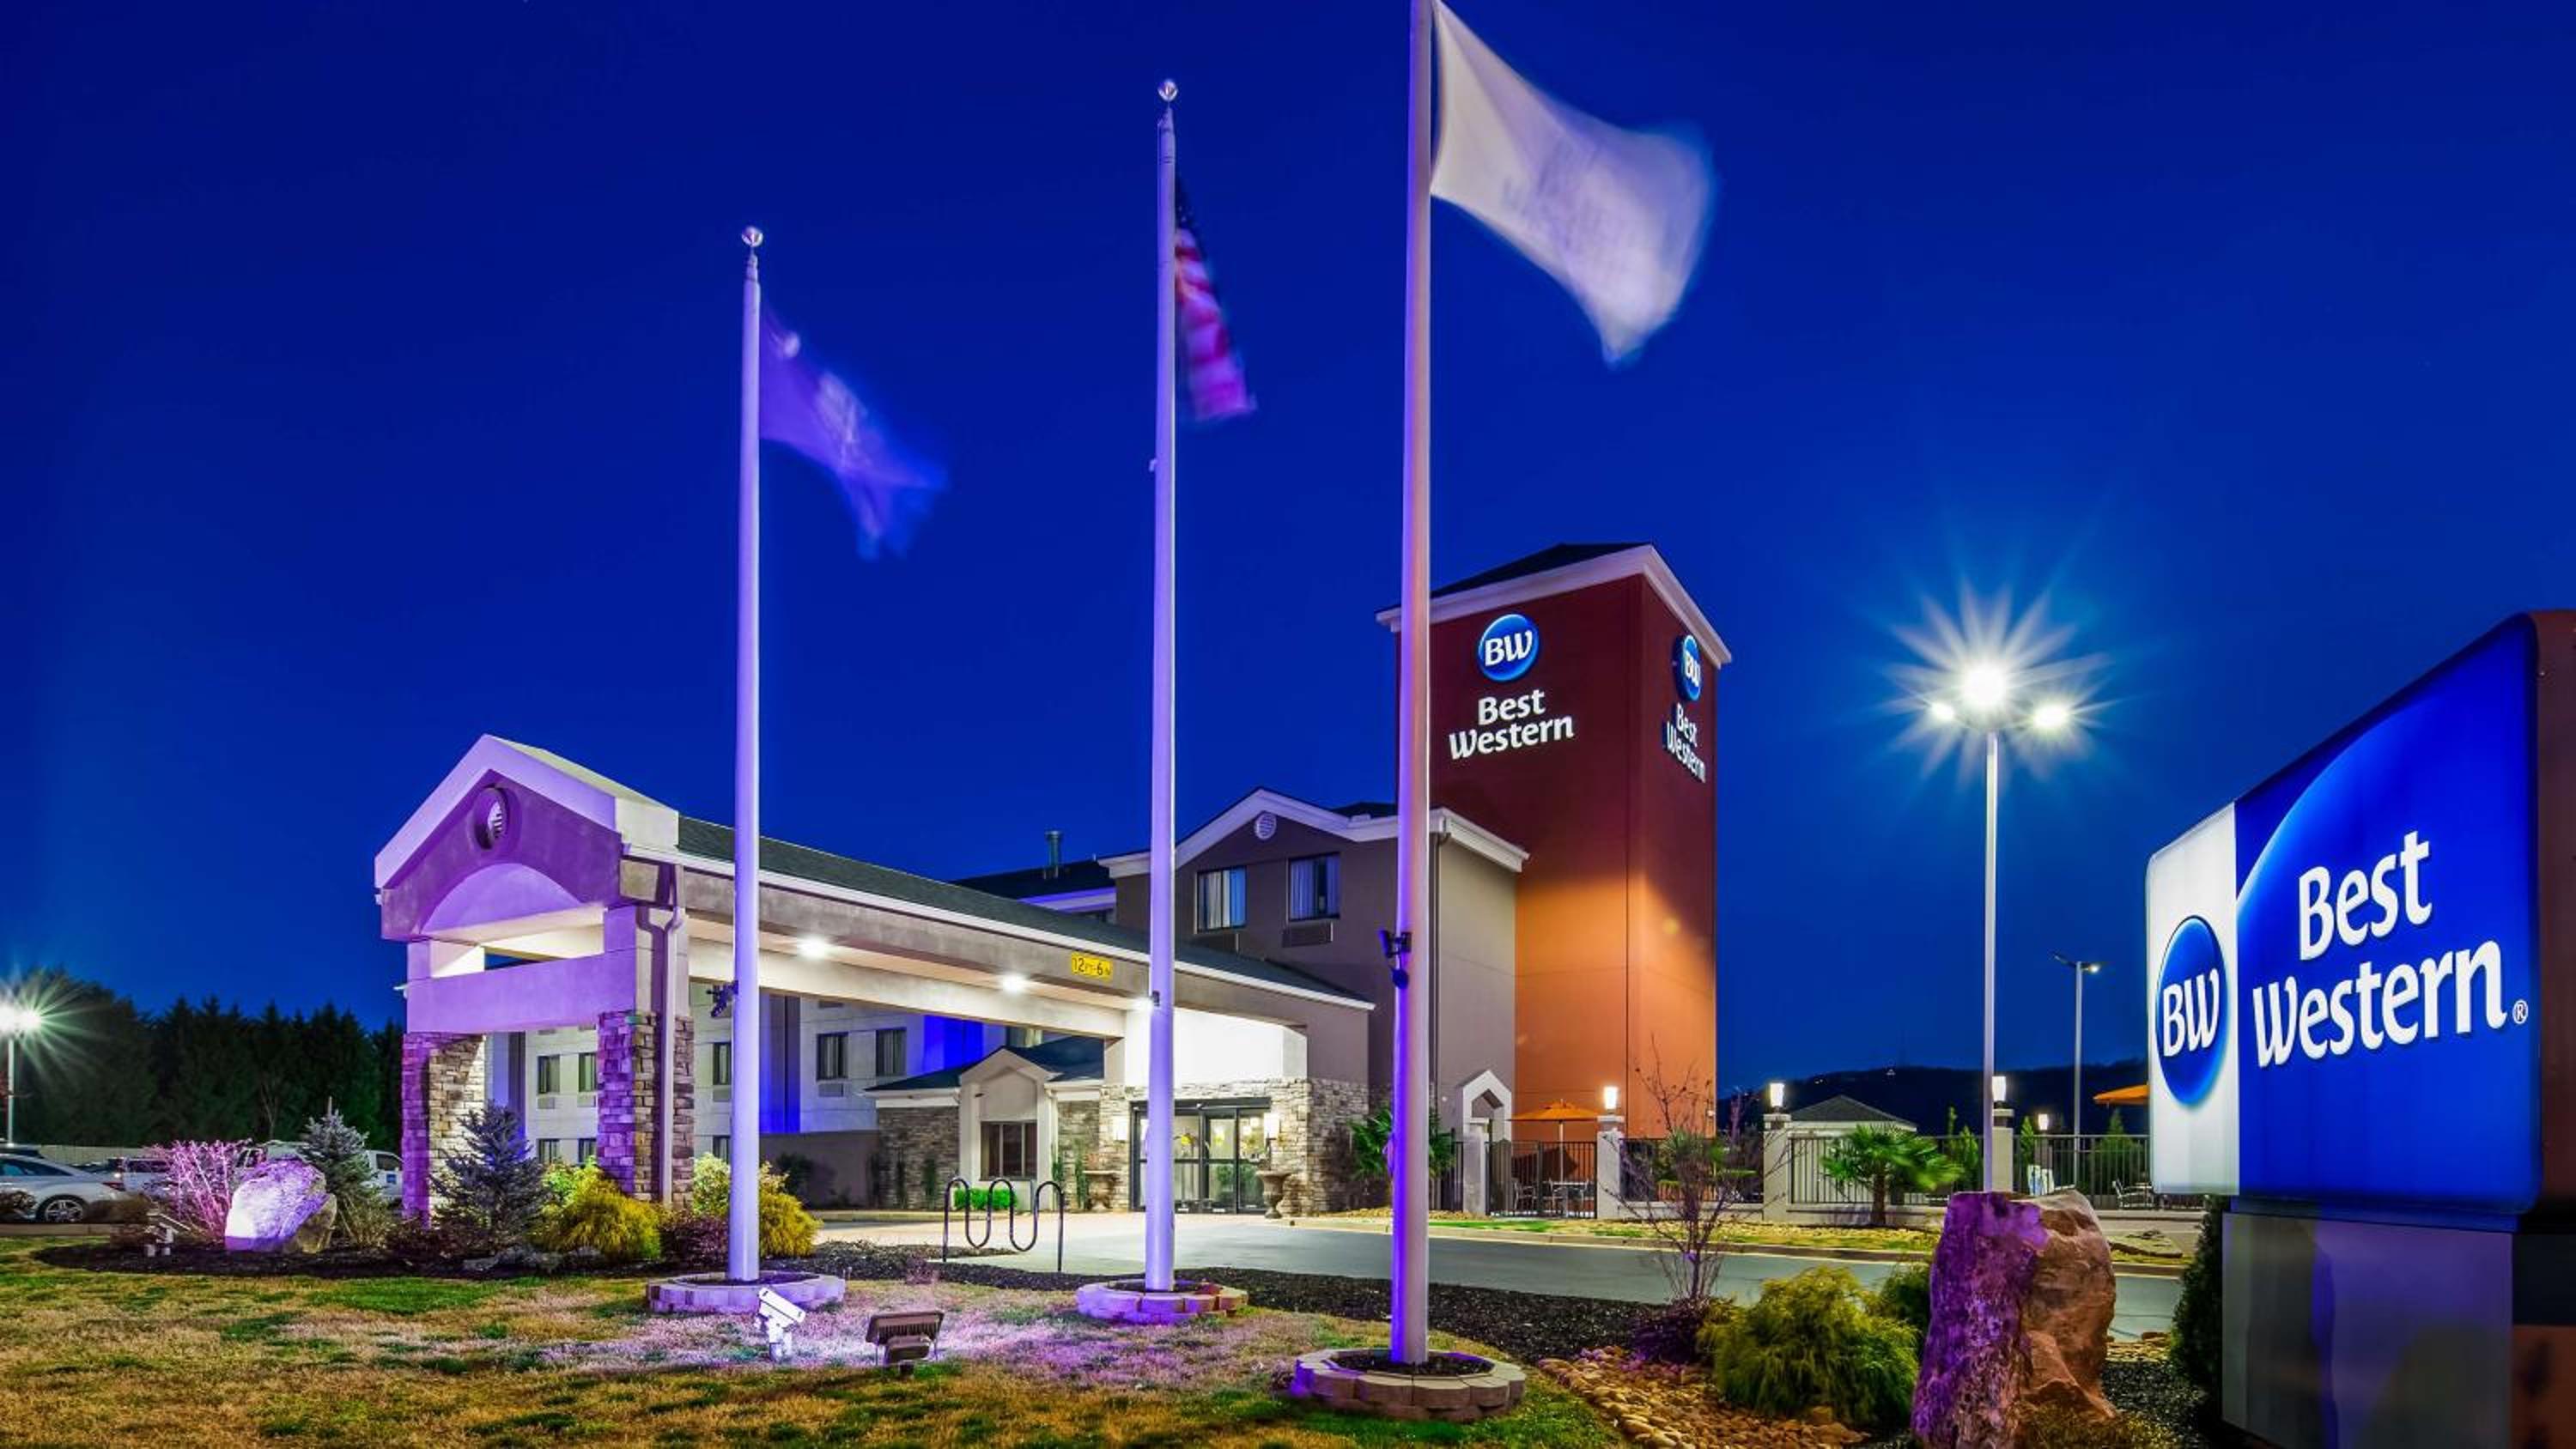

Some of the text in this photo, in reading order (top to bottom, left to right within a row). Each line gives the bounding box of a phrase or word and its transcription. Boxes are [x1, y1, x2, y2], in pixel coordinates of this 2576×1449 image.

[1484, 630, 1533, 666] BW
[1685, 650, 1701, 688] BW
[1478, 689, 1546, 725] Best
[1677, 702, 1698, 748] Best
[1449, 715, 1575, 760] Western
[1667, 721, 1706, 783] Western
[2299, 831, 2432, 961] Best
[2162, 968, 2220, 1057] BW
